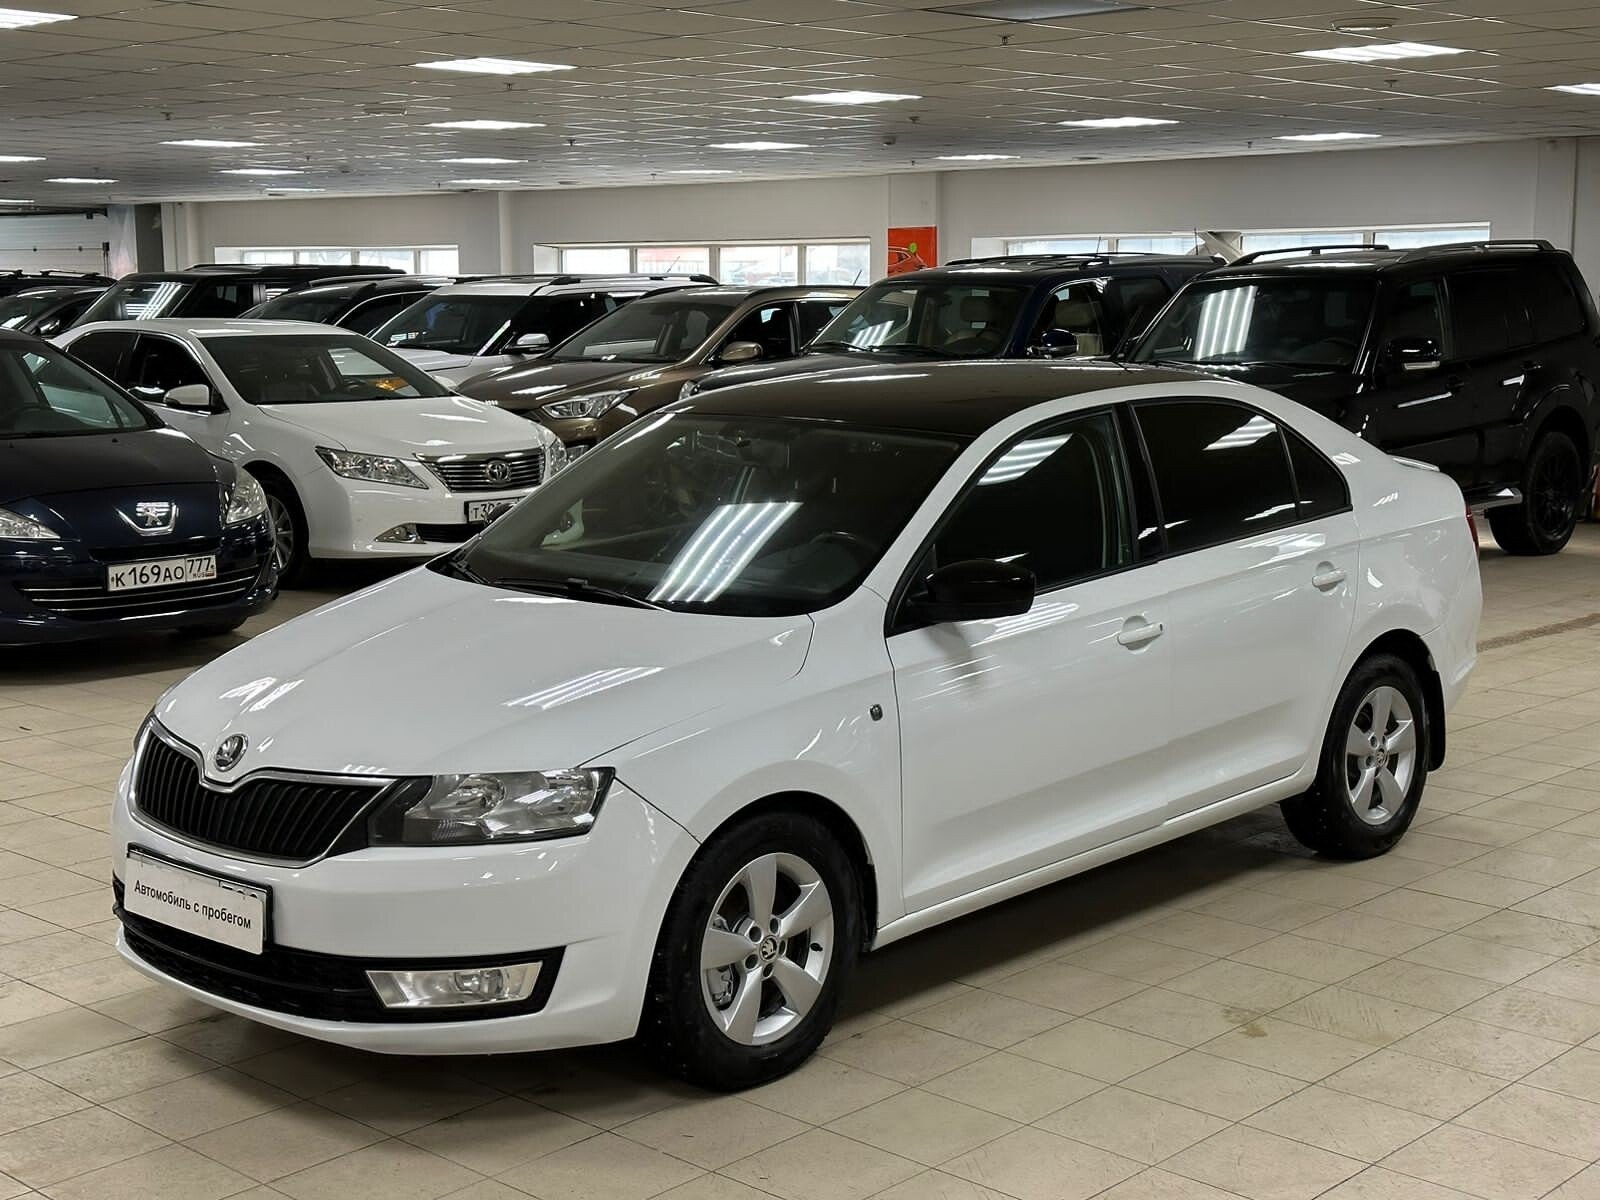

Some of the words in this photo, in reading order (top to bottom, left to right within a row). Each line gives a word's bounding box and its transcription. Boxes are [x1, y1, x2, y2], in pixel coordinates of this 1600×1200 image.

[187, 557, 212, 574] 777
[134, 879, 191, 911] Автомобиль
[193, 902, 200, 913] с
[201, 904, 251, 929] пробегом
